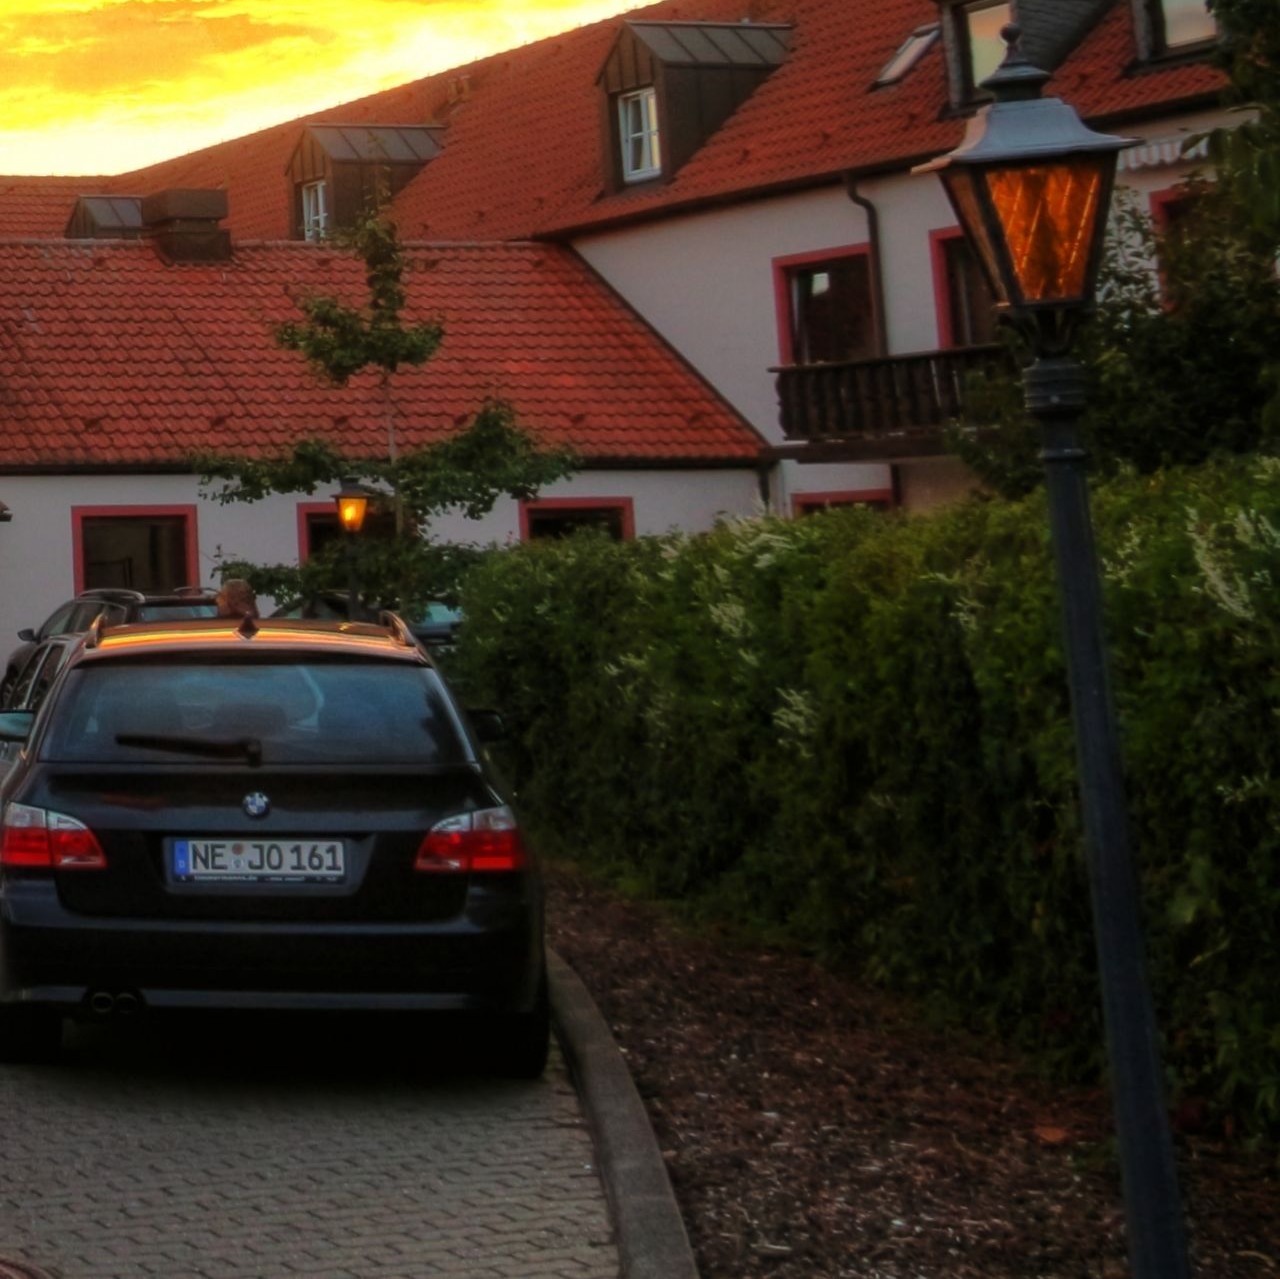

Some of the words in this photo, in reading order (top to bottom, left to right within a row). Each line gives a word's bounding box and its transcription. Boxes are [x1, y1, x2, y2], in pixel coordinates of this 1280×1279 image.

[191, 843, 228, 871] NE
[247, 843, 284, 871] JO
[289, 844, 343, 872] 161
